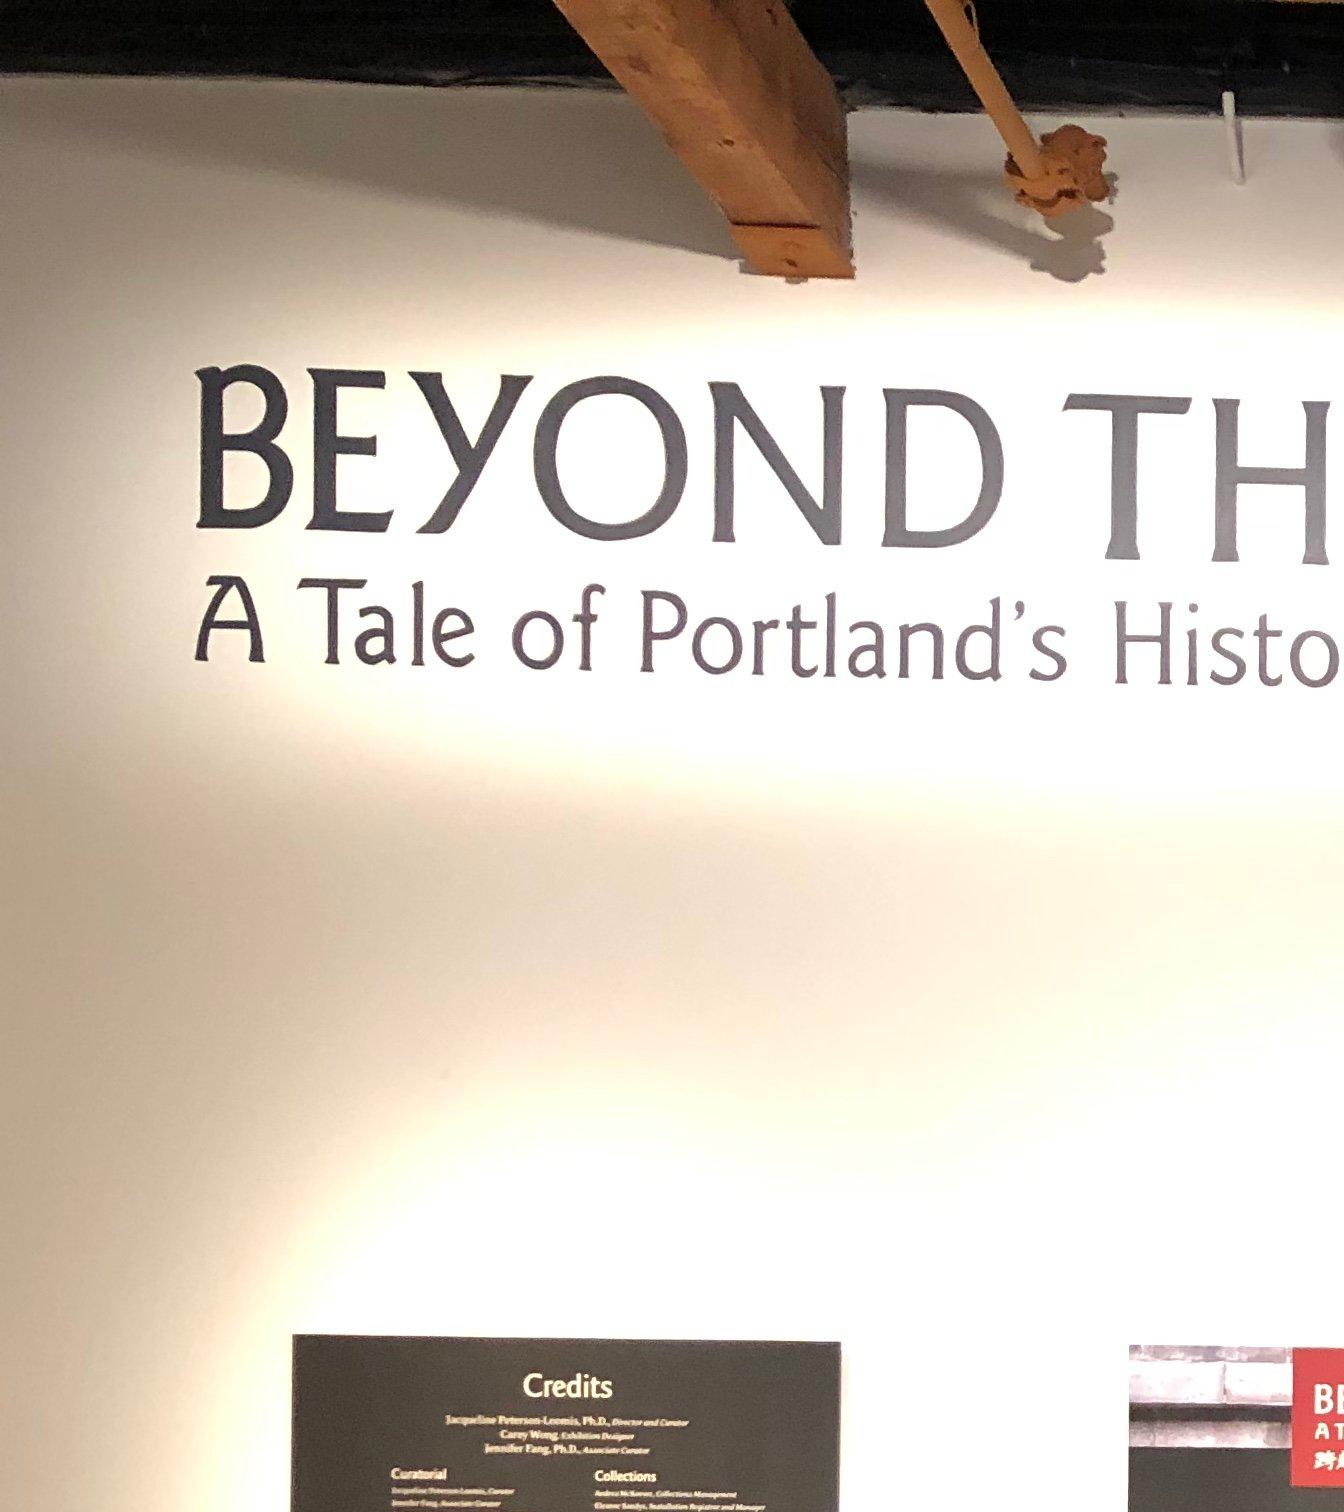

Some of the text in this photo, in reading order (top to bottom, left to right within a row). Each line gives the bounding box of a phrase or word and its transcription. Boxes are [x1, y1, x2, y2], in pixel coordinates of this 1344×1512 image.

[194, 362, 1004, 549] BEYOND
[195, 575, 265, 663] A
[297, 578, 474, 667] Tale
[512, 584, 605, 671] of
[641, 591, 1066, 681] Portland's
[524, 1373, 612, 1398] Credits
[1315, 1423, 1329, 1439] A
[391, 1468, 446, 1480] Curatorial
[595, 1470, 656, 1482] Collections
